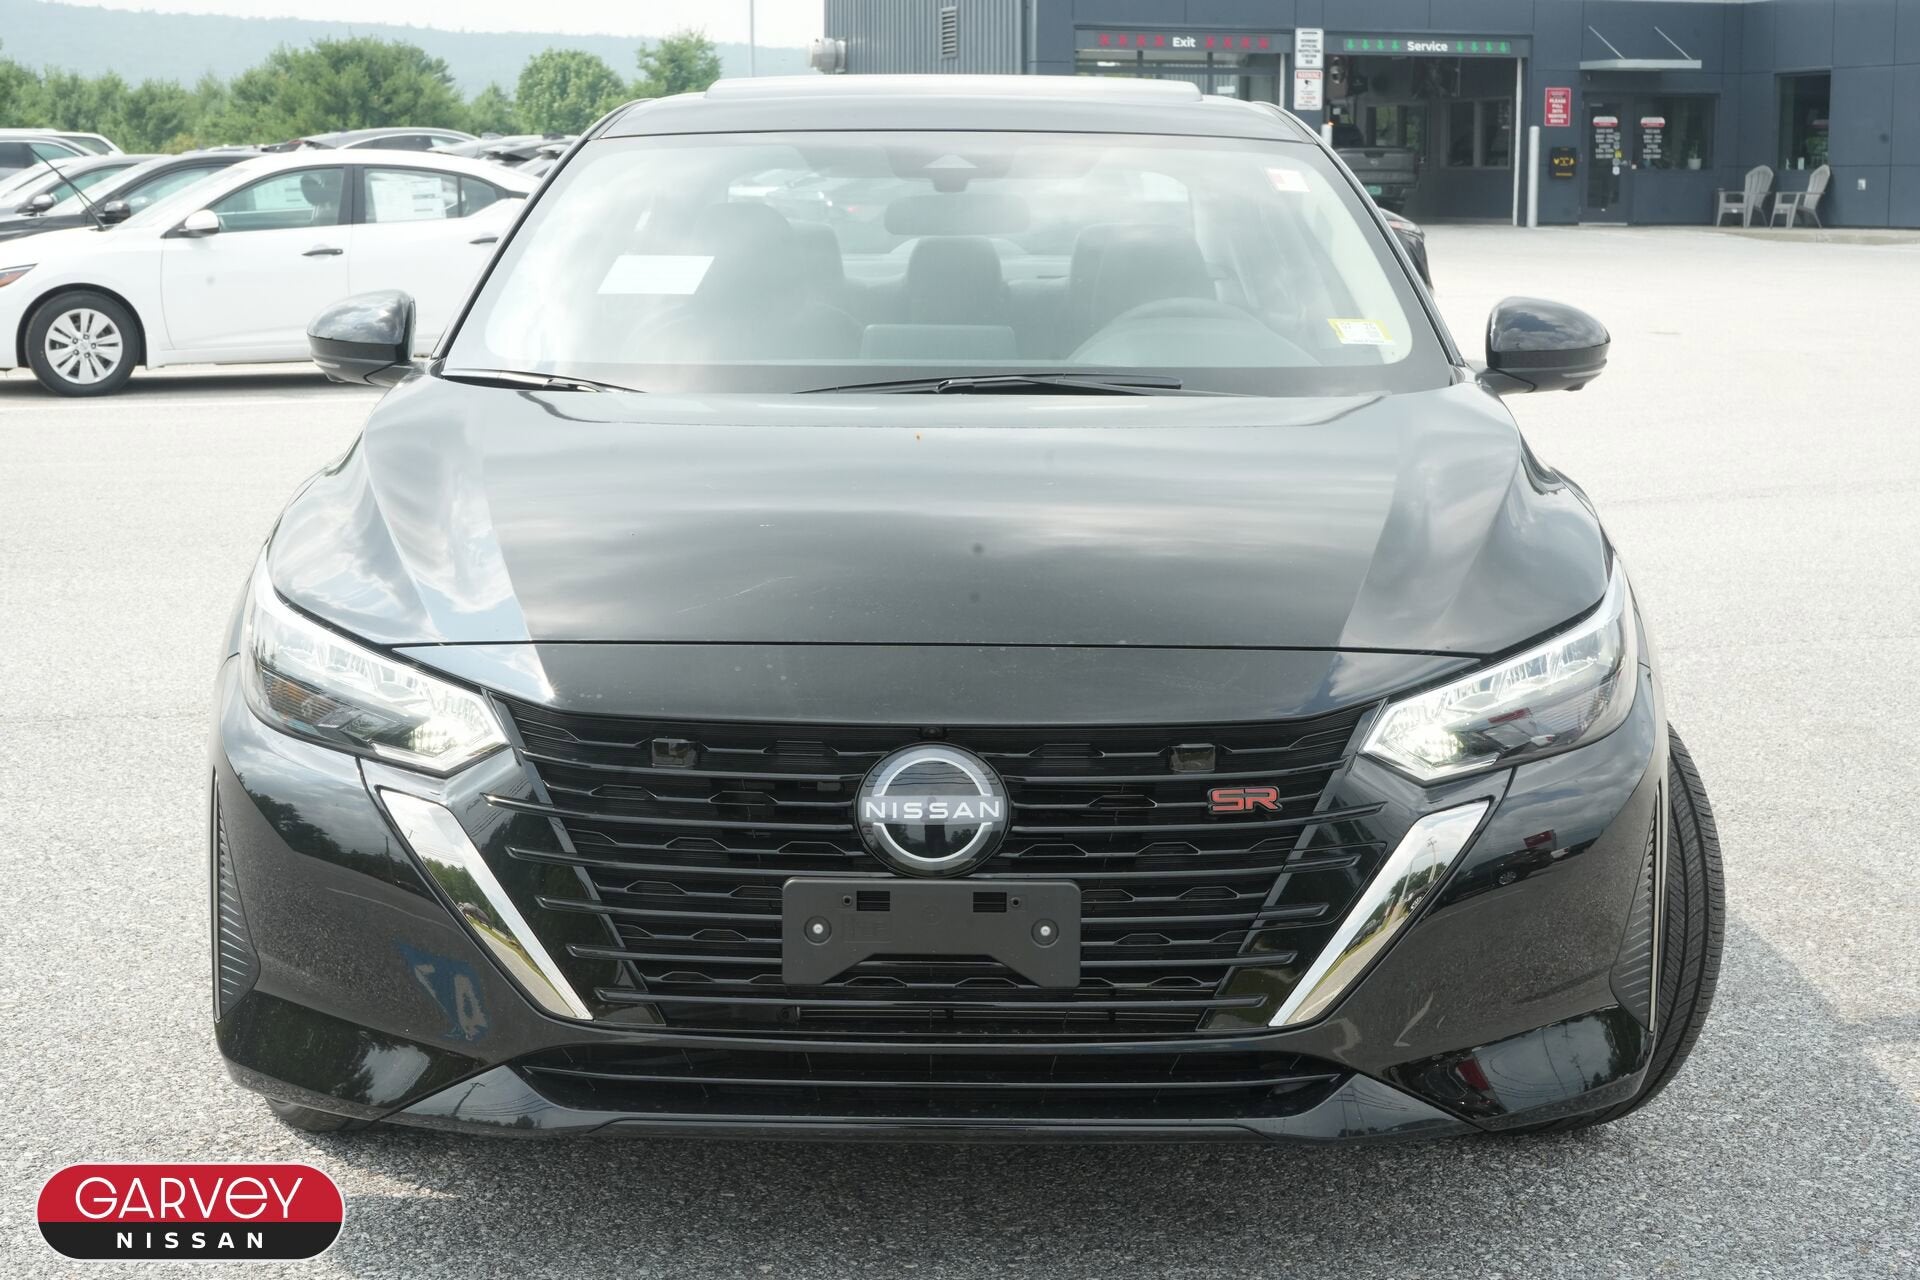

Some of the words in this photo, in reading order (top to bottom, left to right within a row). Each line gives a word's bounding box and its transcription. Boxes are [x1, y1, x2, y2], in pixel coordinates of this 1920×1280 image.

[1172, 37, 1196, 48] Exit
[1407, 41, 1449, 52] Service
[1208, 786, 1281, 814] SR
[865, 800, 1000, 820] NISSAN
